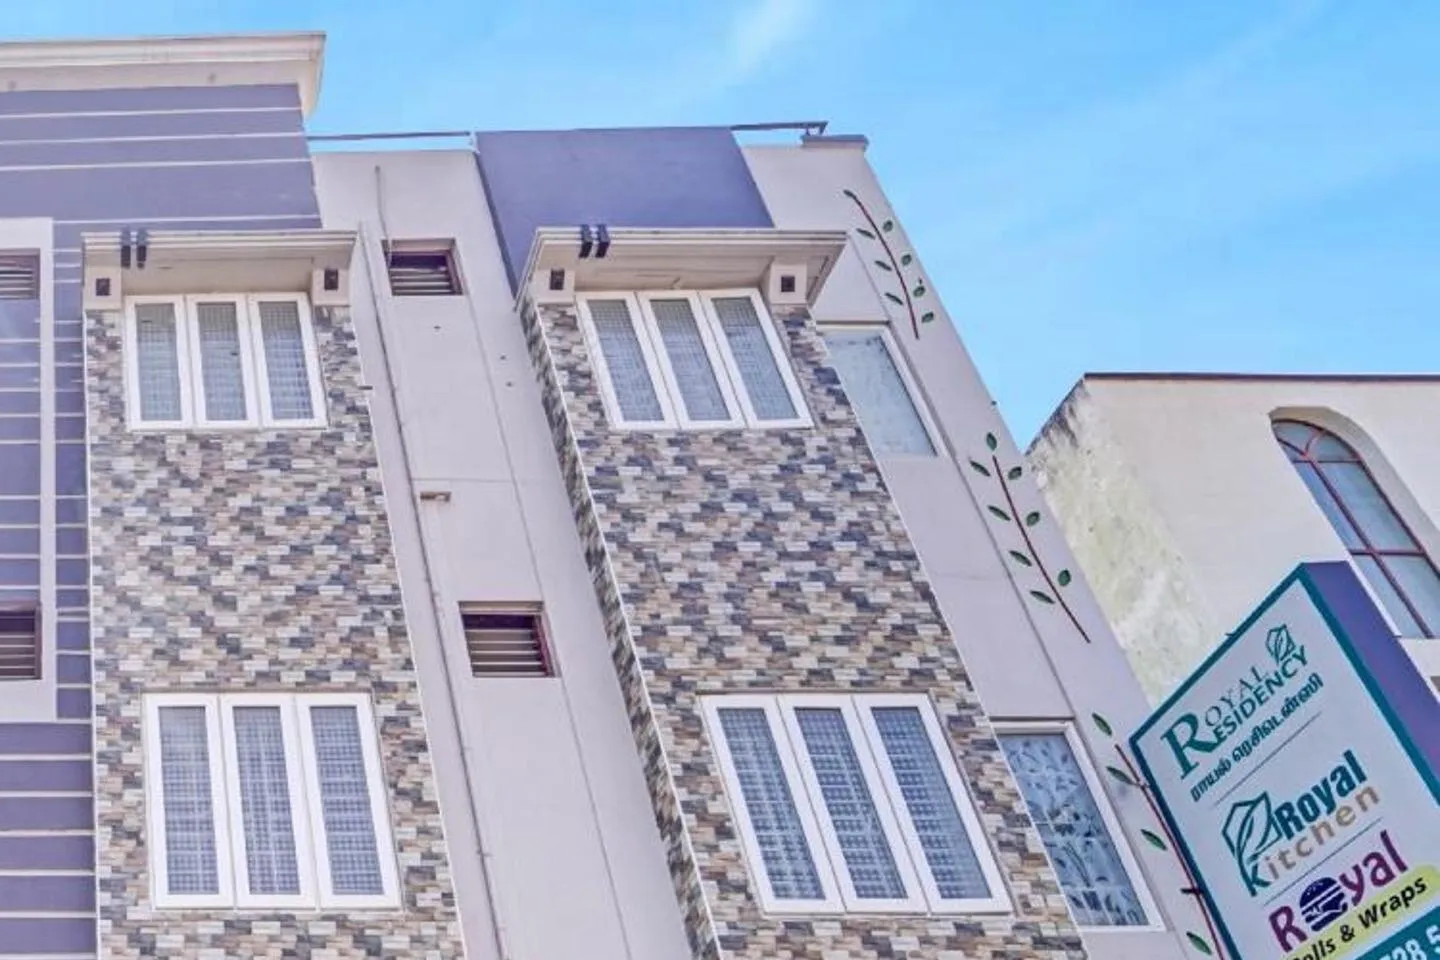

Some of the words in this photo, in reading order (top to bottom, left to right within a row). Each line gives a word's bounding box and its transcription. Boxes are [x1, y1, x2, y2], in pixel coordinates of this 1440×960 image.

[1274, 749, 1367, 840] Royal
[1339, 924, 1356, 942] &
[1358, 877, 1427, 930] Wraps
